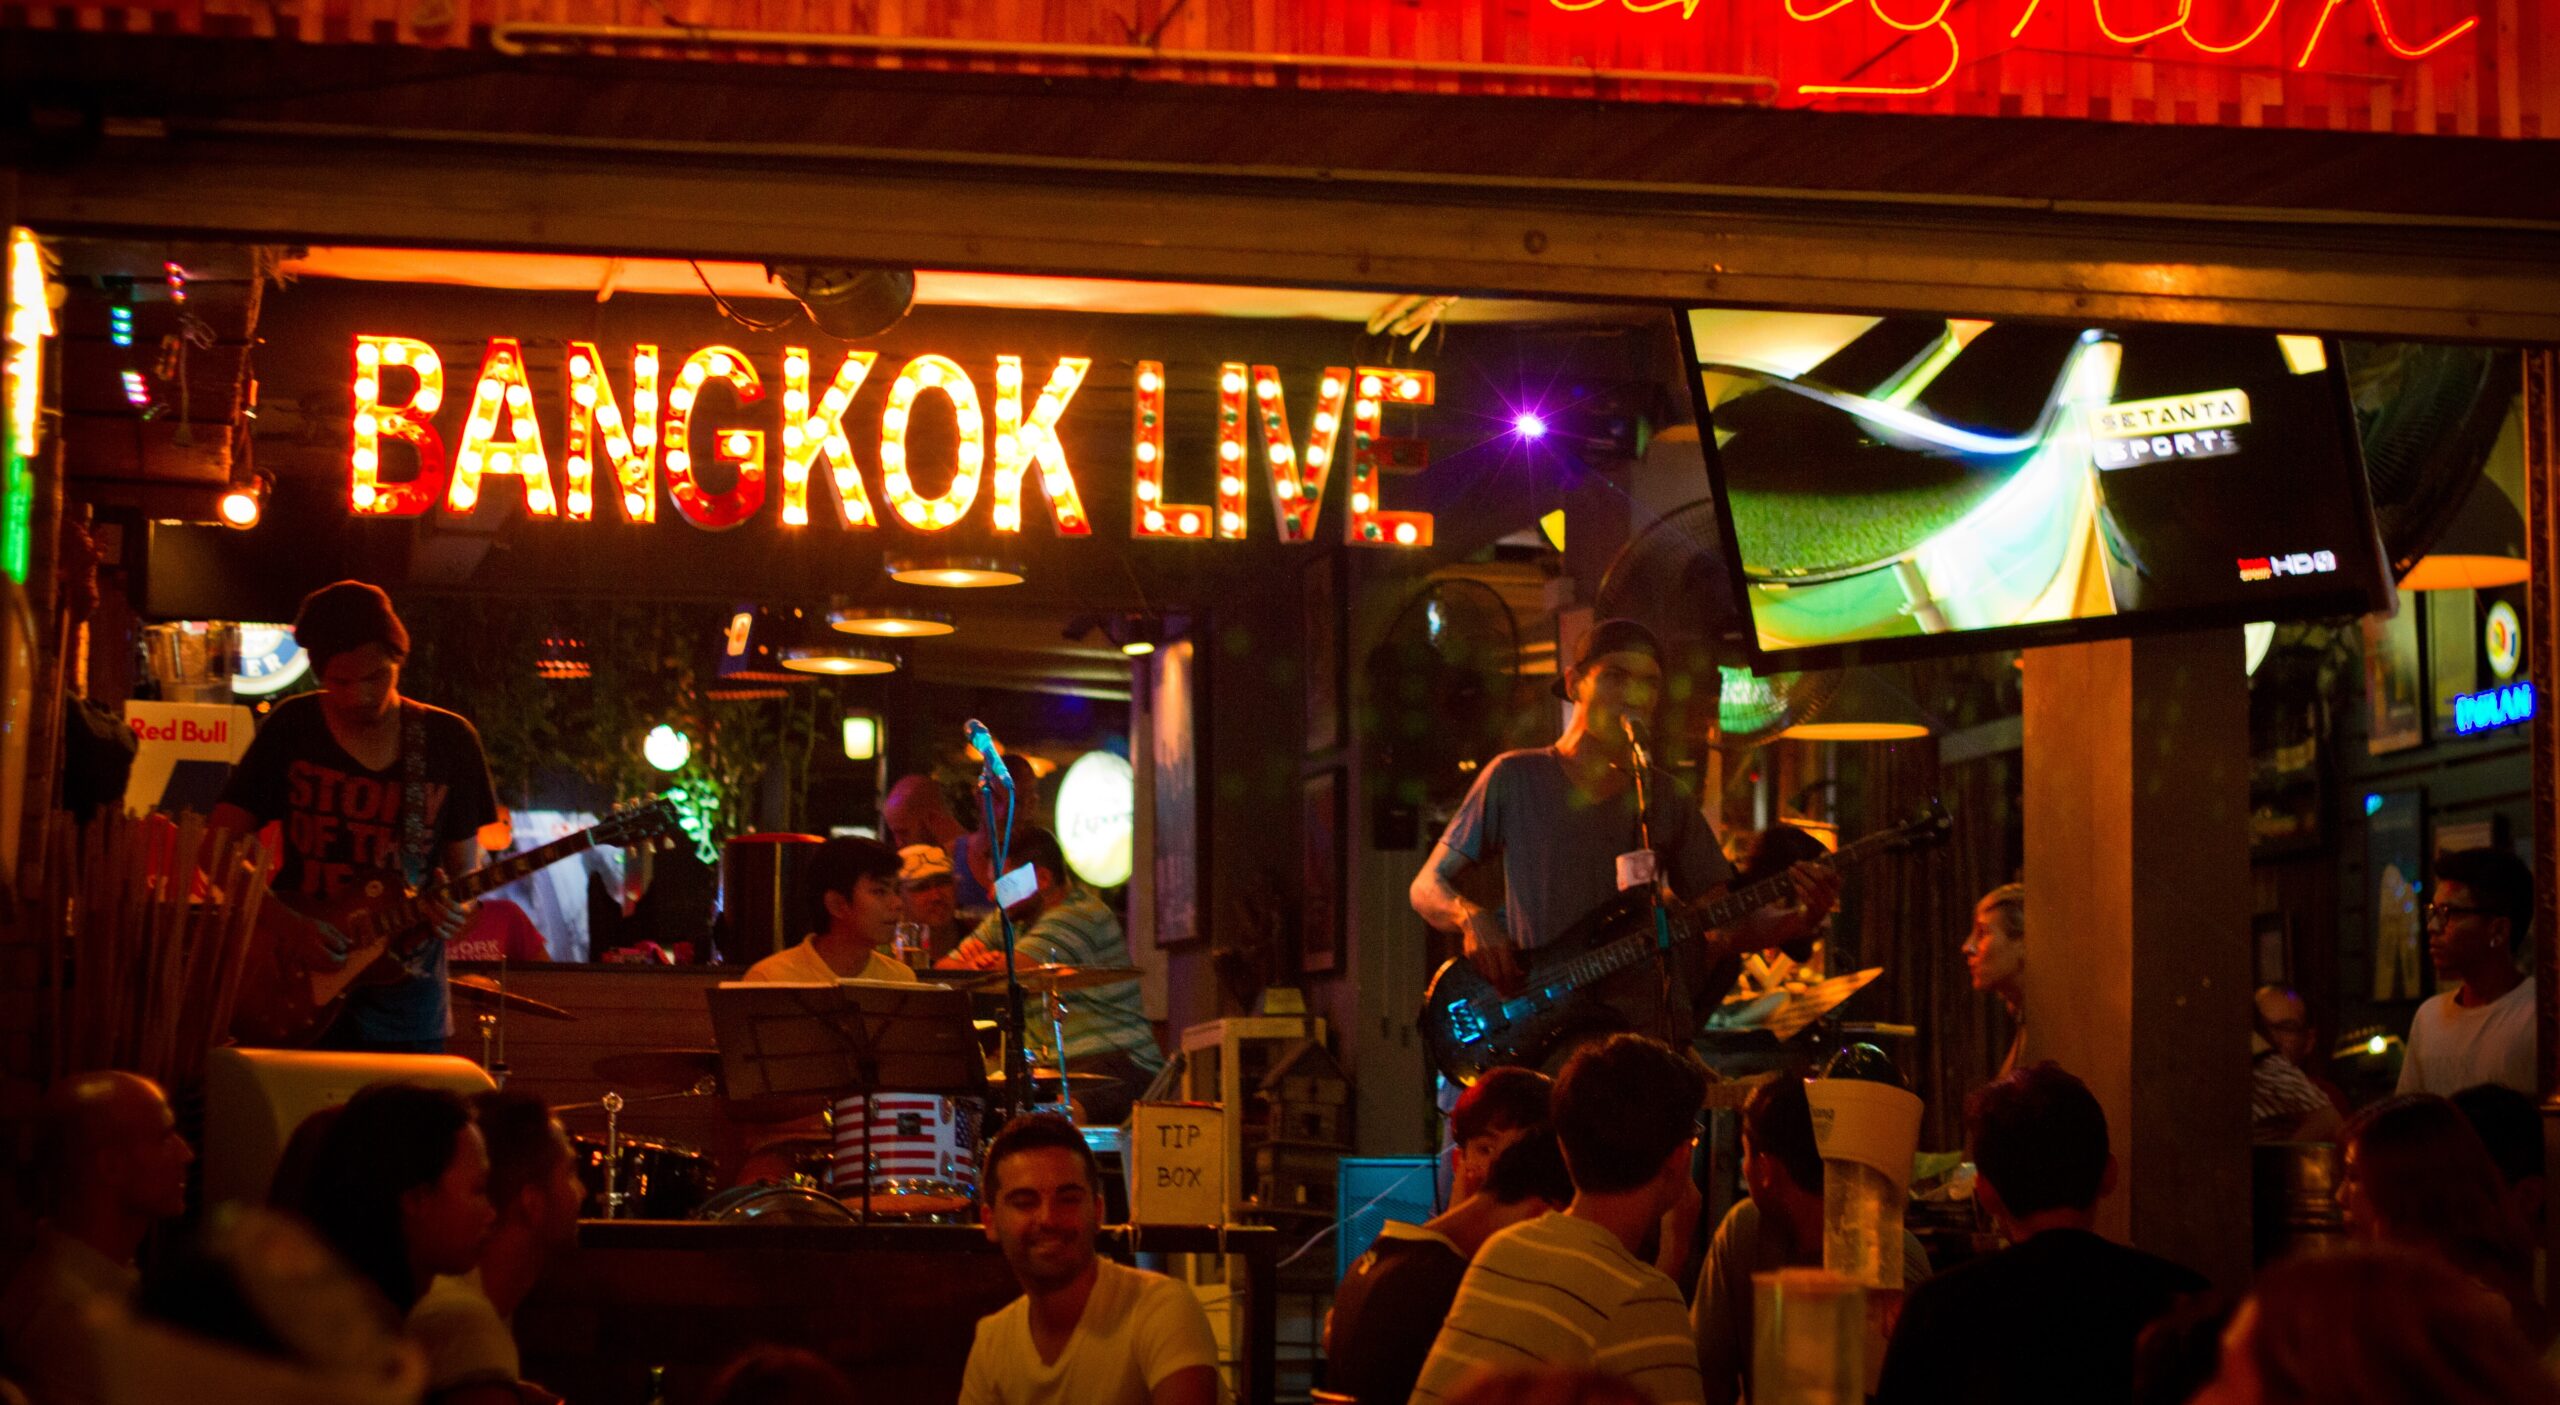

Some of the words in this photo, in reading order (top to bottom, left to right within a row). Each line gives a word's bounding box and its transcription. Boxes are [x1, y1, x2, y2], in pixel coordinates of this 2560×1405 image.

[2102, 400, 2236, 430] SETANTA
[349, 334, 1092, 538] BANGKOK
[1131, 361, 1437, 547] LIVE
[2109, 429, 2240, 462] SPORTS
[131, 718, 176, 741] Red
[181, 720, 227, 743] Bull
[1156, 1124, 1202, 1148] TIP
[1157, 1166, 1203, 1188] BOX
